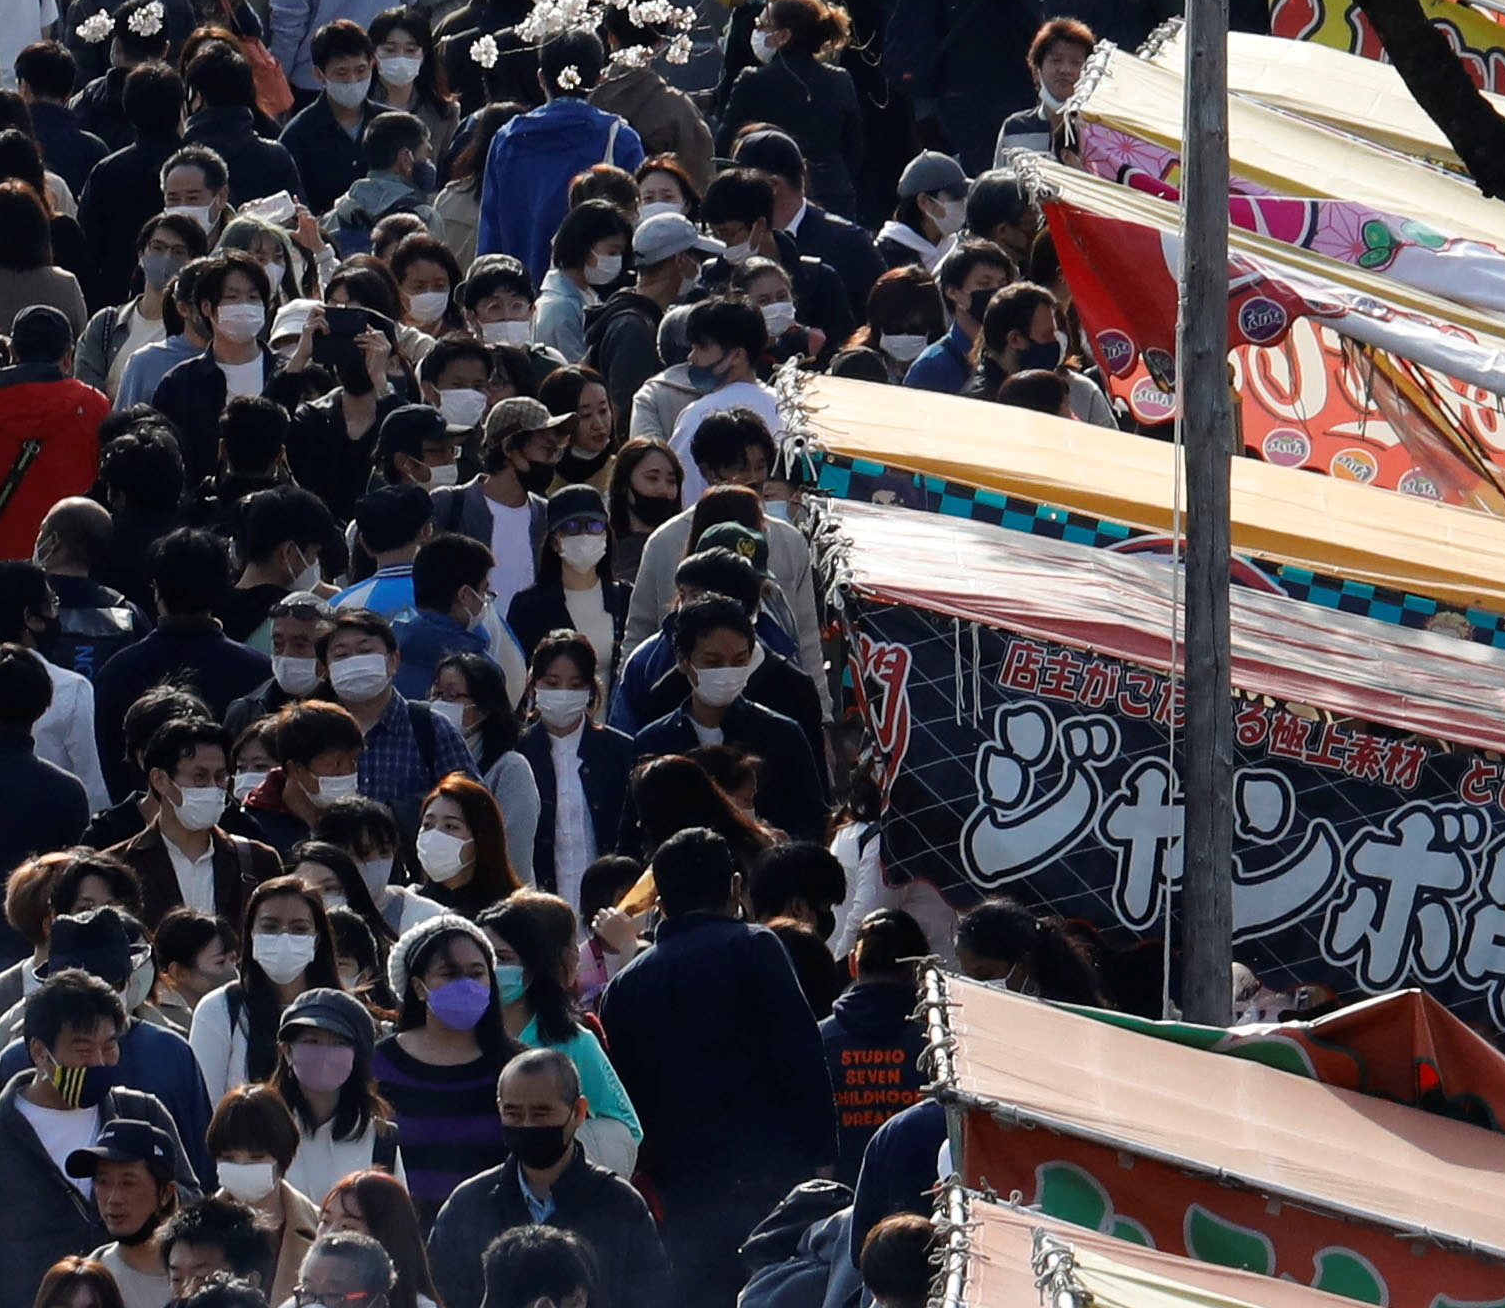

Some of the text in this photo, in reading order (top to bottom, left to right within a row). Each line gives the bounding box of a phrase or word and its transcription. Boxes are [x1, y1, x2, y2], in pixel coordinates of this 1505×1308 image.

[841, 1049, 905, 1065] STUDIO
[846, 1069, 901, 1085] SEVEN
[841, 1111, 893, 1126] DREA
